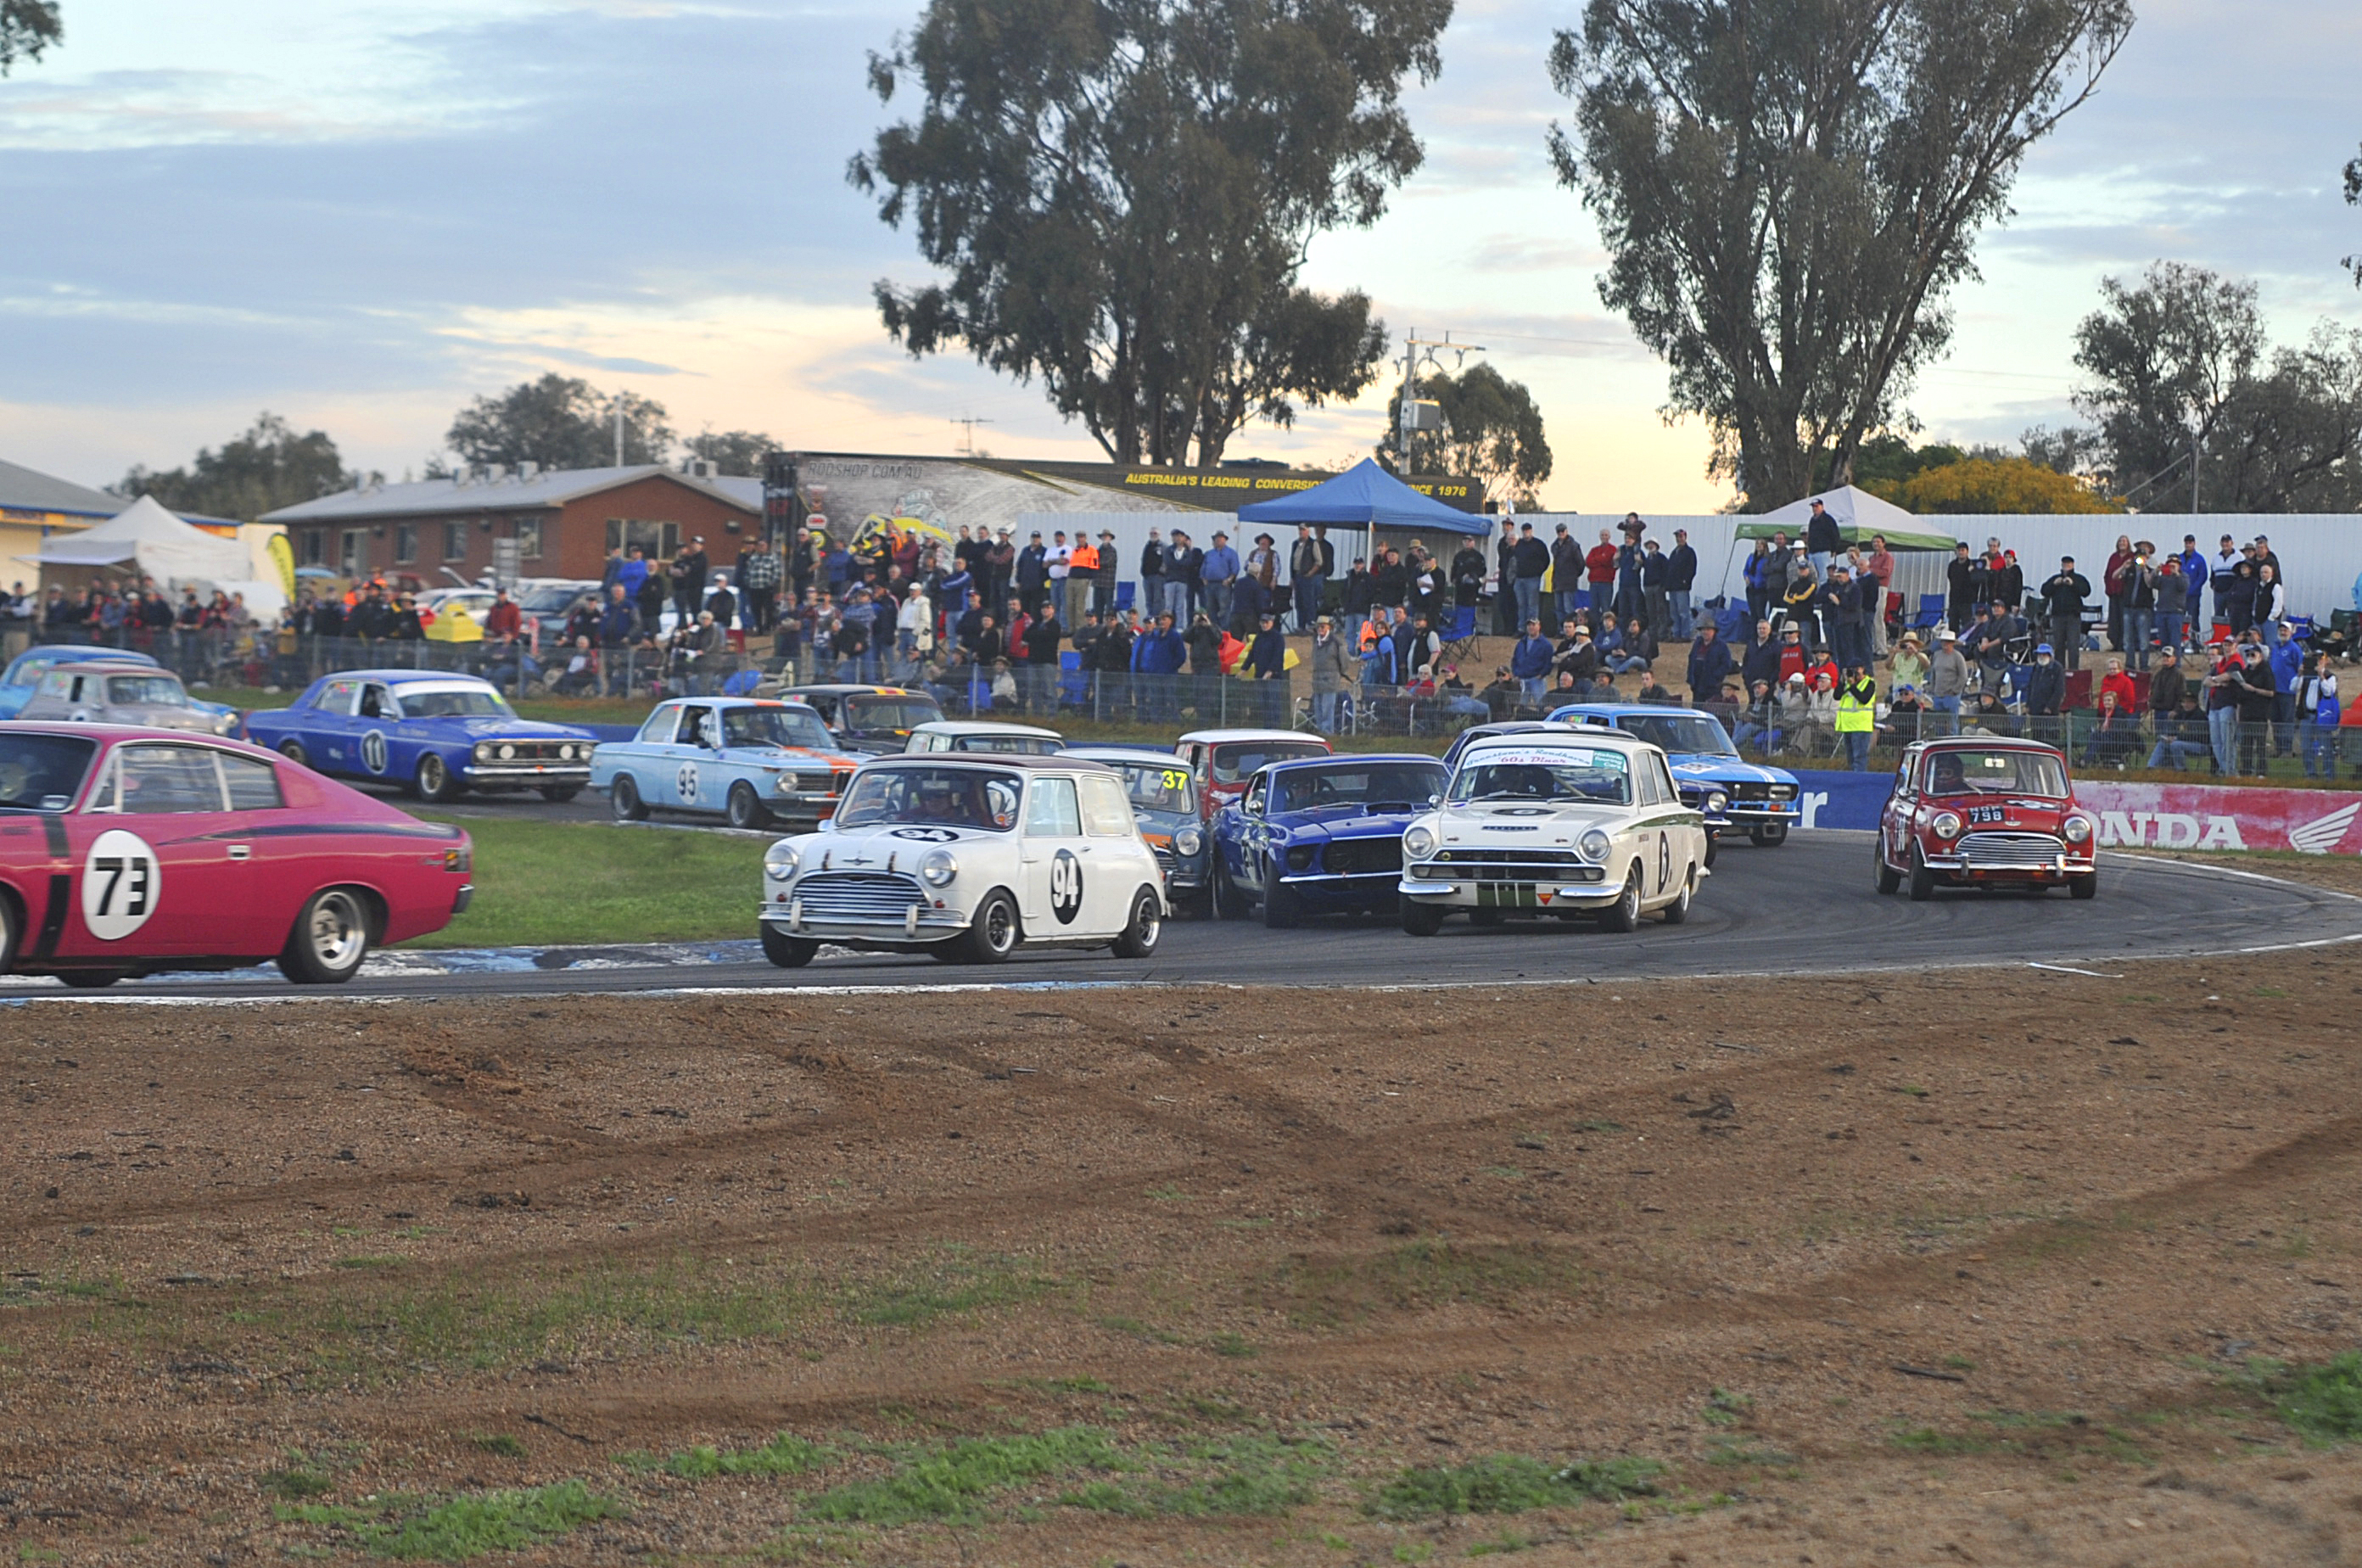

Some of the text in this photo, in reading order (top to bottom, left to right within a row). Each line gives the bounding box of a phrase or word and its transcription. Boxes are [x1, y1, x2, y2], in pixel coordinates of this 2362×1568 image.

[1125, 473, 1198, 486] AUSTRALIA'S
[1201, 475, 1251, 488] LEADING
[1255, 478, 1328, 490] CONVERSIO
[1438, 485, 1467, 496] 1976
[679, 768, 696, 797] 95
[1161, 770, 1188, 790] 37
[1972, 811, 2002, 823] 798
[2081, 809, 2248, 850] NDA
[897, 829, 952, 842] 94
[94, 857, 148, 916] 73
[1053, 857, 1079, 909] 94
